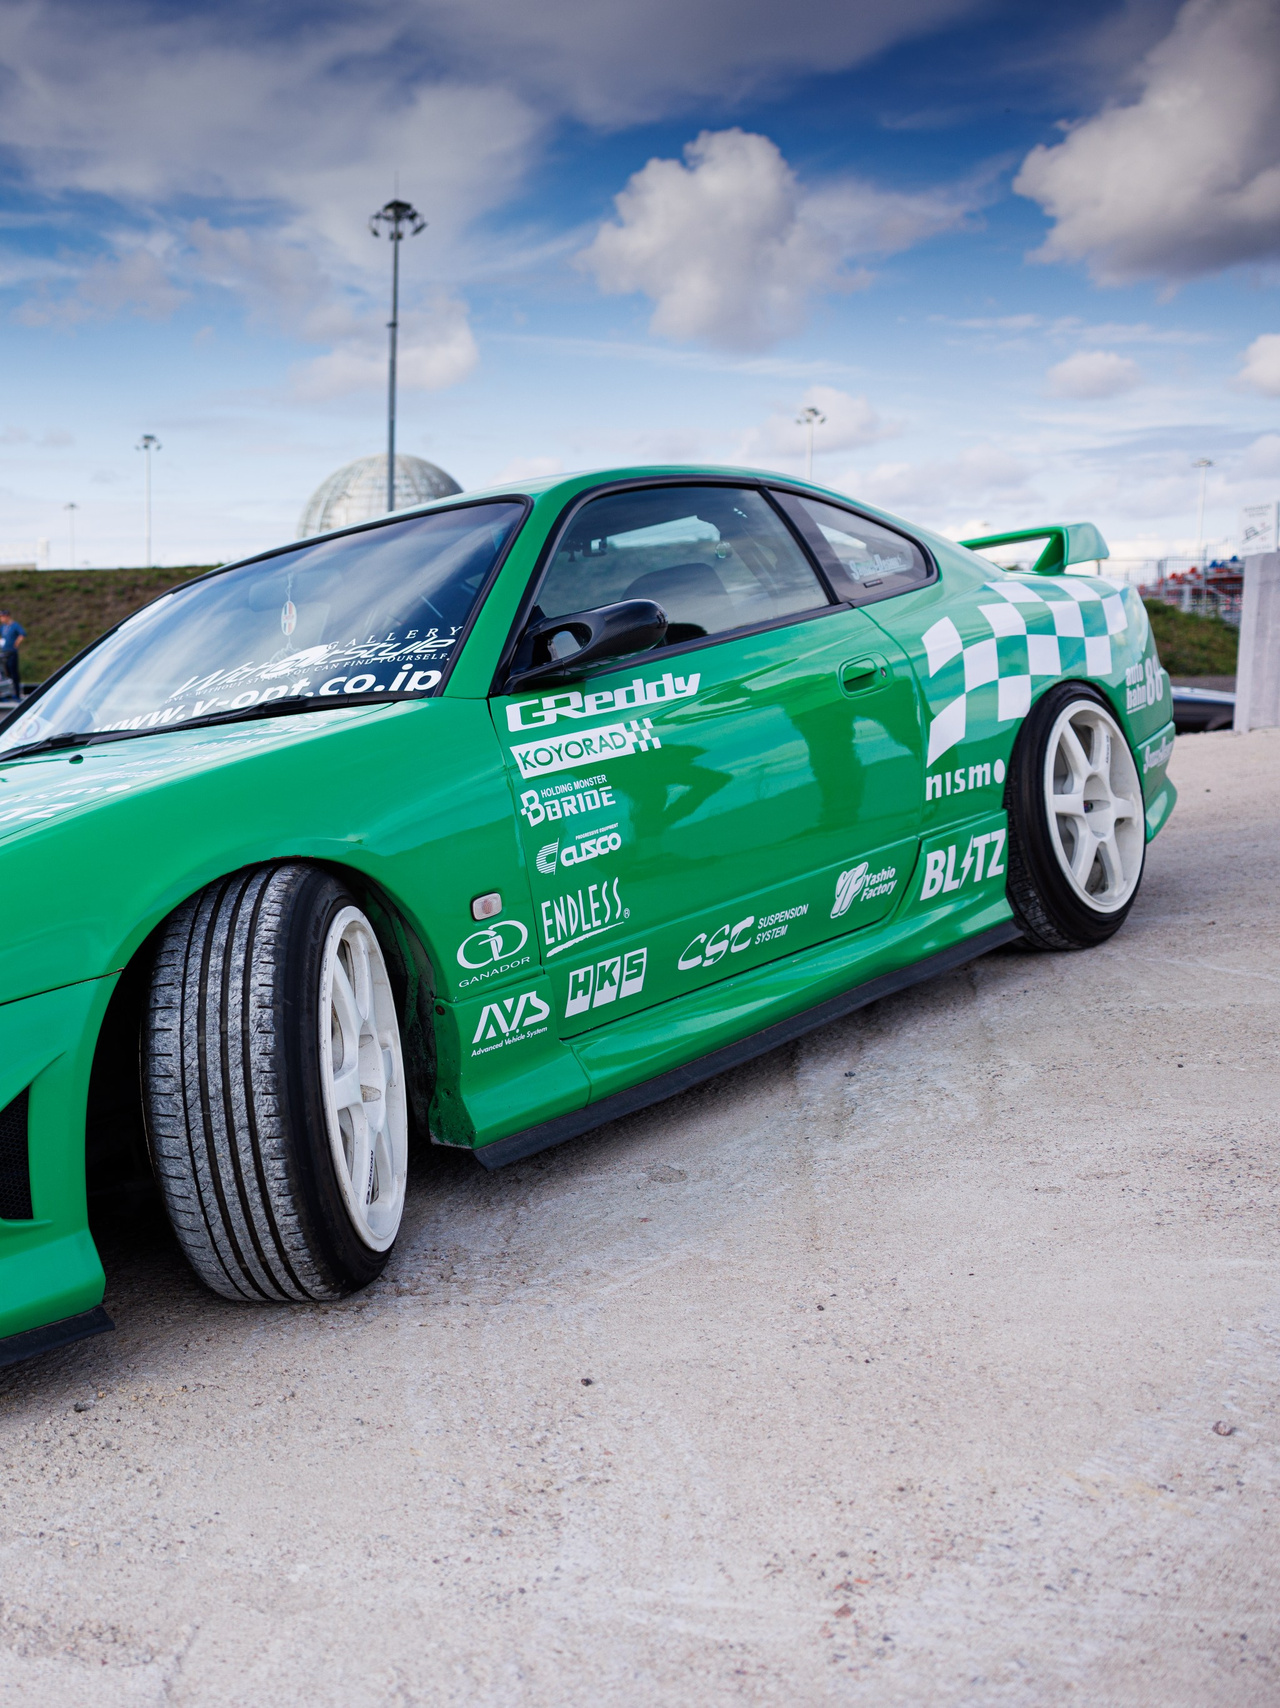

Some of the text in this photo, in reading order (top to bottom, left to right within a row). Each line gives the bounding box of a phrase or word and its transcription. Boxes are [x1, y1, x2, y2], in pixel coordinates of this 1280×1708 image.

[327, 626, 463, 650] GALLERY
[314, 663, 340, 672] CAN
[343, 659, 374, 668] FIND
[1125, 662, 1144, 687] auto
[505, 673, 701, 732] GReddy
[518, 731, 627, 771] KOYORAD
[541, 774, 607, 798] HOLDING MONSTER
[925, 759, 1006, 801] nismo
[544, 785, 616, 821] BRIDE
[560, 832, 622, 867] CUSCO
[920, 828, 1006, 901] BLITZ
[860, 880, 898, 902] Factory
[865, 866, 896, 887] Yashio
[757, 904, 809, 929] SUSPENSION
[677, 916, 755, 971] CSC
[755, 925, 788, 945] SYSTEM
[458, 956, 531, 988] GANADOR
[568, 949, 646, 1011] HKS
[472, 991, 550, 1044] AVS
[471, 1027, 548, 1057] Advanced Vehicle System
